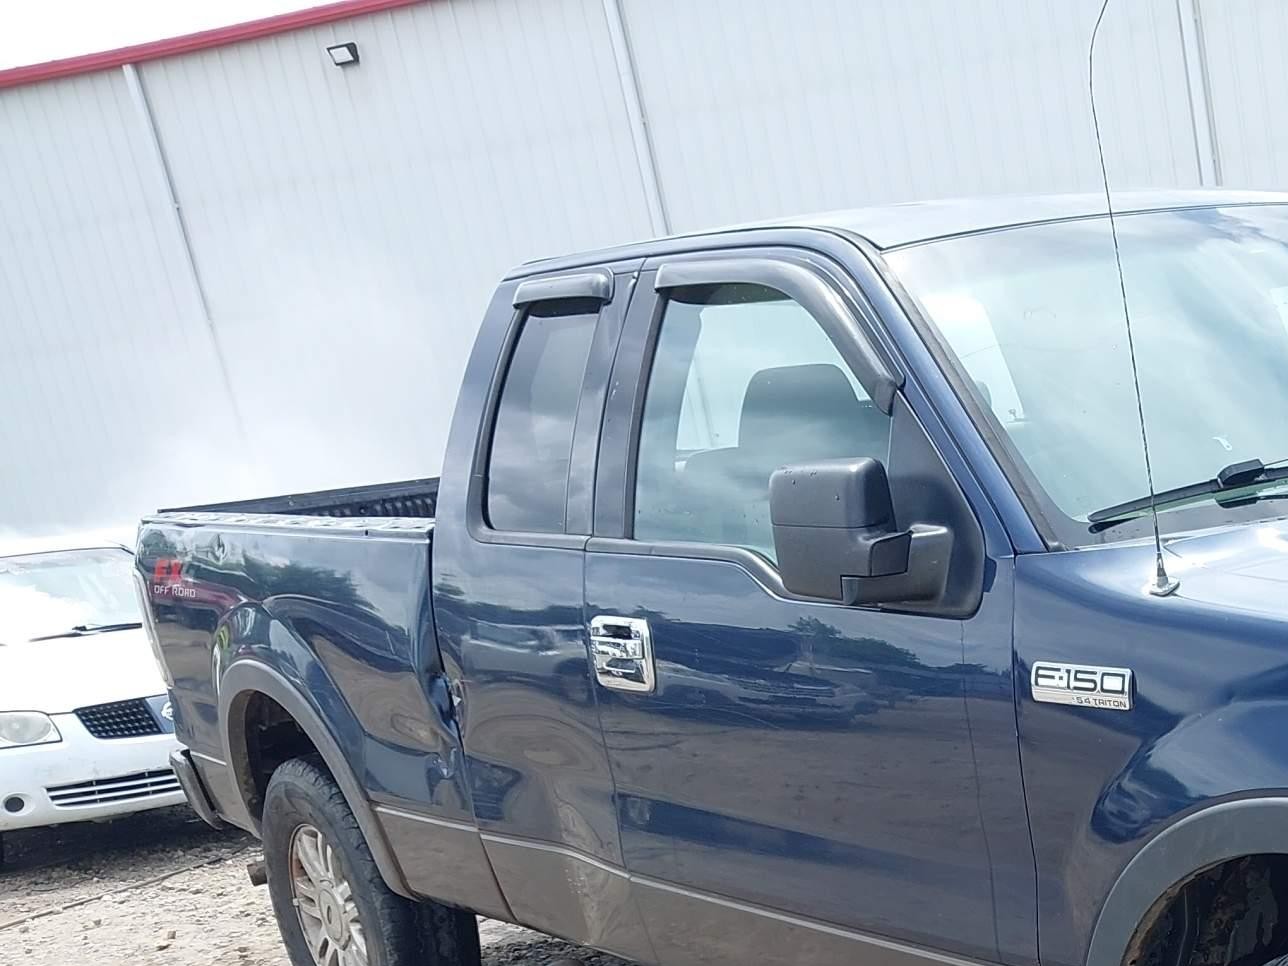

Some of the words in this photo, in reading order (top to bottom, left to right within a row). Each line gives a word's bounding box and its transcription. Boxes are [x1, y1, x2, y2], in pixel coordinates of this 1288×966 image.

[153, 585, 169, 596] OFF
[172, 587, 196, 598] ROAD
[1093, 698, 1127, 708] TRITON
